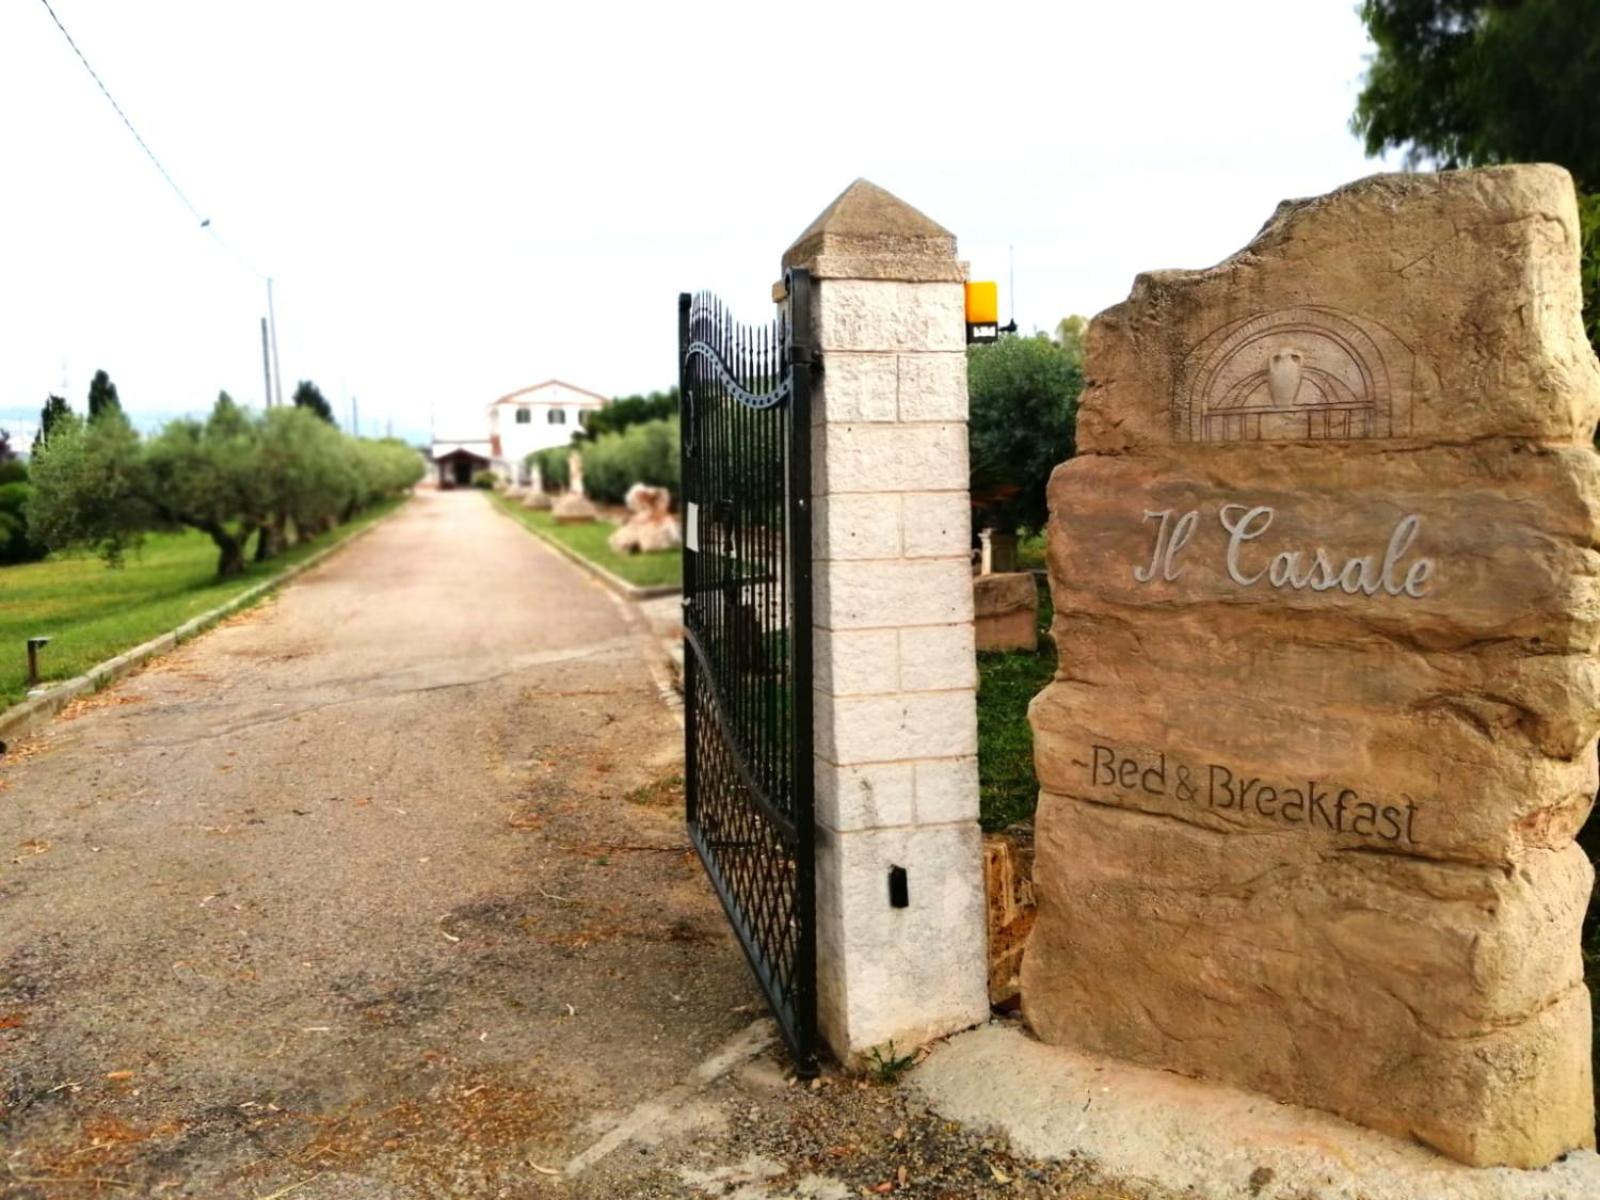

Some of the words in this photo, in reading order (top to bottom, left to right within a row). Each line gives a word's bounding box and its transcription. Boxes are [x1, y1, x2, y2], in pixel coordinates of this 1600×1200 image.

[1133, 509, 1199, 582] Il
[1219, 503, 1437, 598] Casale
[1174, 764, 1199, 802] &
[1206, 764, 1421, 845] Breakfast
